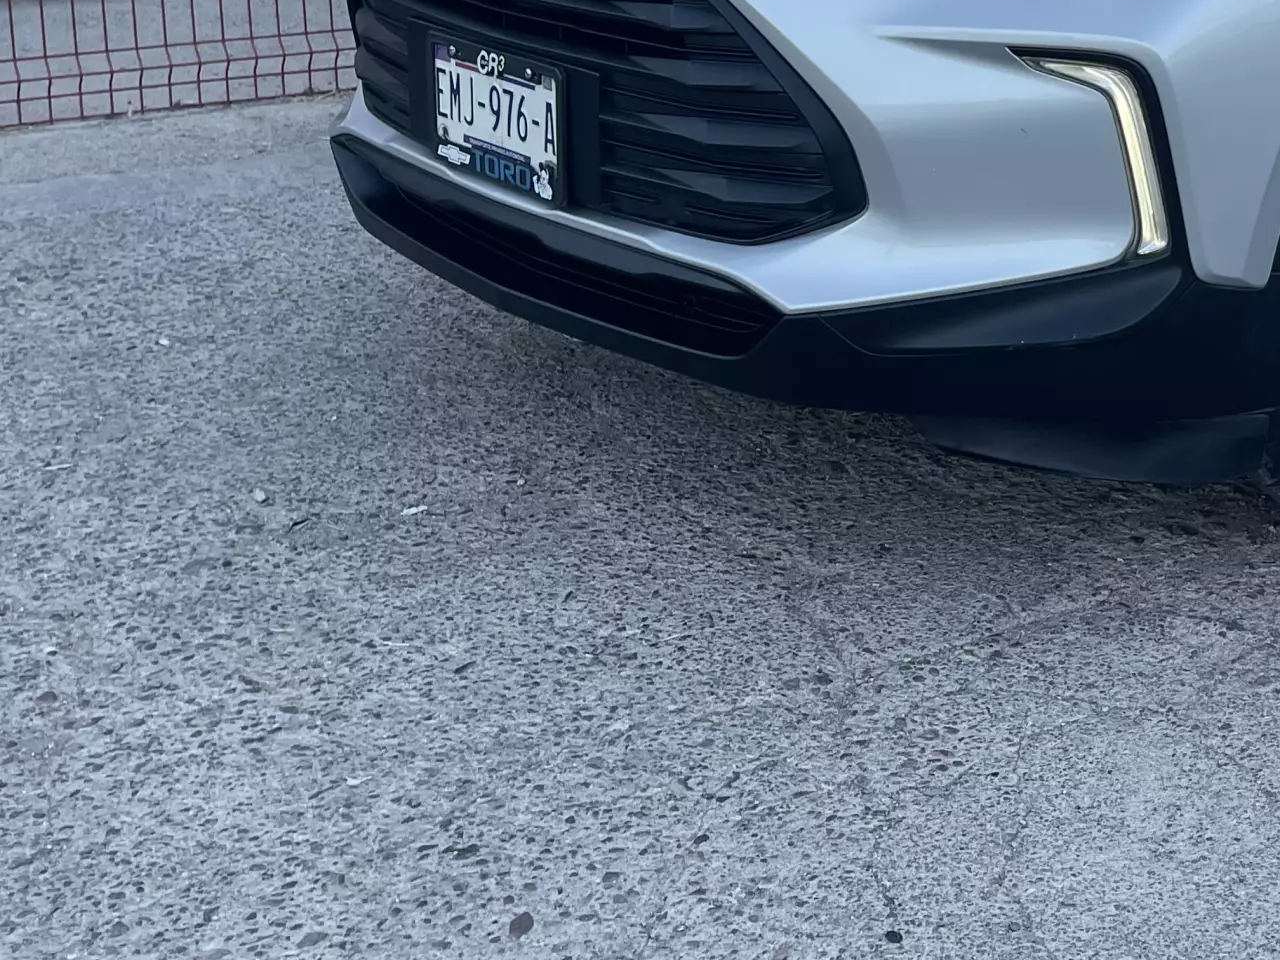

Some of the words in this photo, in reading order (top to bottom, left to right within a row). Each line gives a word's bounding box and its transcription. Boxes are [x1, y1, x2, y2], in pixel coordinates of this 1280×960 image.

[477, 49, 505, 79] CR3
[437, 67, 556, 156] EMJ-976-A
[471, 148, 531, 190] TORO
